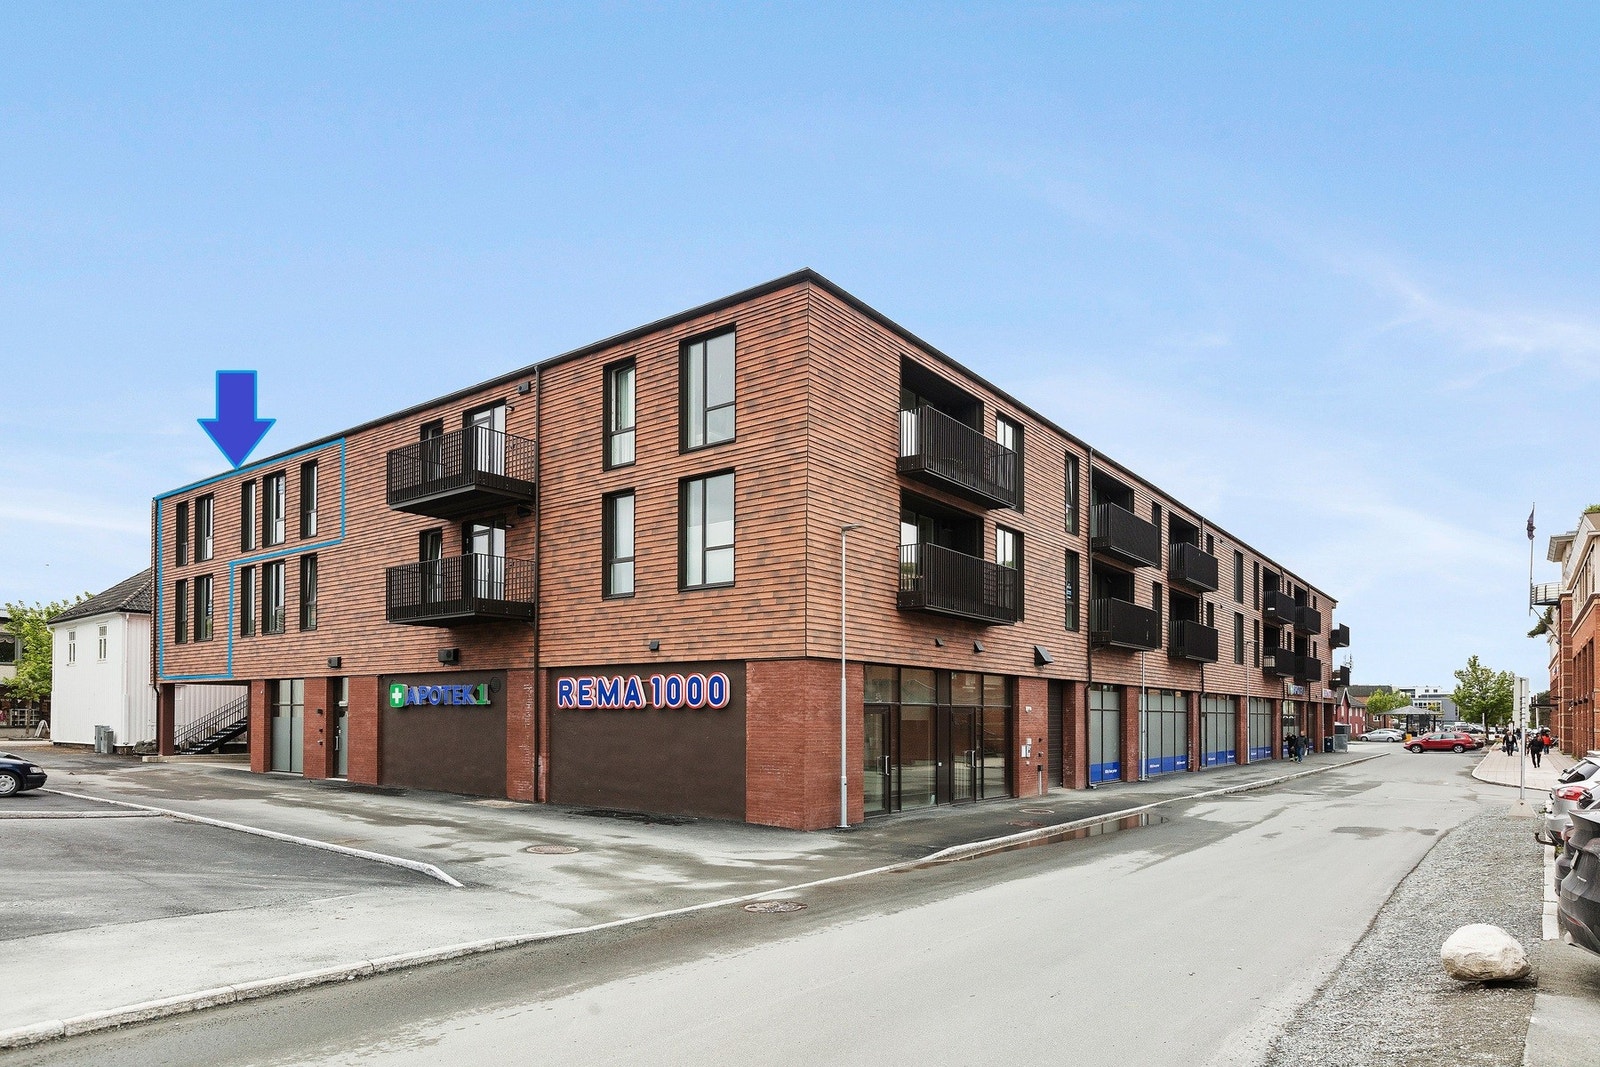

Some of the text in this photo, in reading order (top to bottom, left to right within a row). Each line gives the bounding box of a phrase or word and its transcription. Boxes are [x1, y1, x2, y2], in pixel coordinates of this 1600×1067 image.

[406, 683, 491, 705] APOTEK 1
[556, 671, 730, 710] REMA 1000
